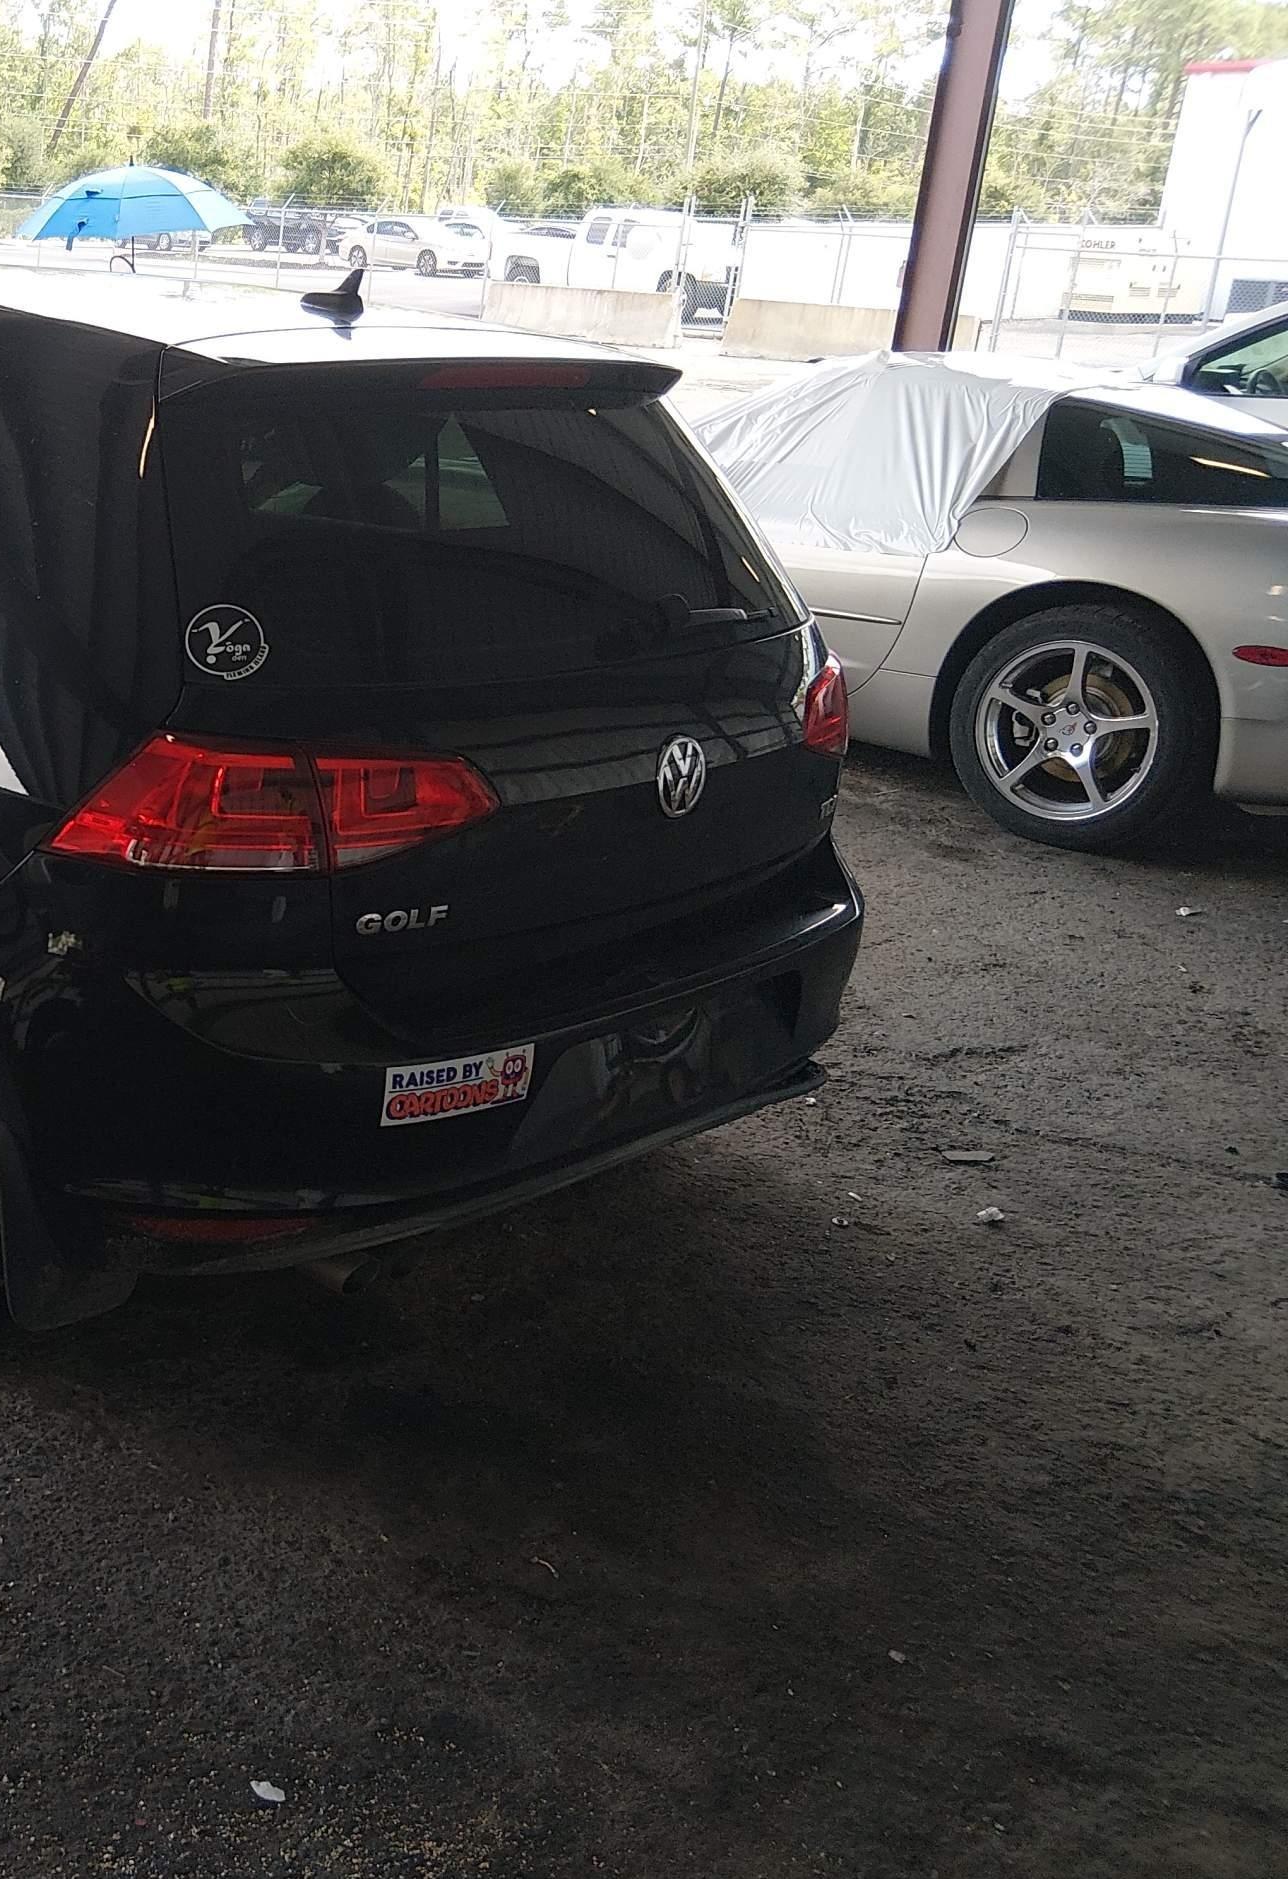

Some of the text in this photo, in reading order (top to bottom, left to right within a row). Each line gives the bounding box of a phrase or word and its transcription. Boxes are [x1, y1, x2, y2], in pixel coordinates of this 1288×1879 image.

[356, 904, 449, 935] GOLF
[392, 1060, 484, 1090] RAISED BY
[386, 1078, 500, 1121] CARTOONS
